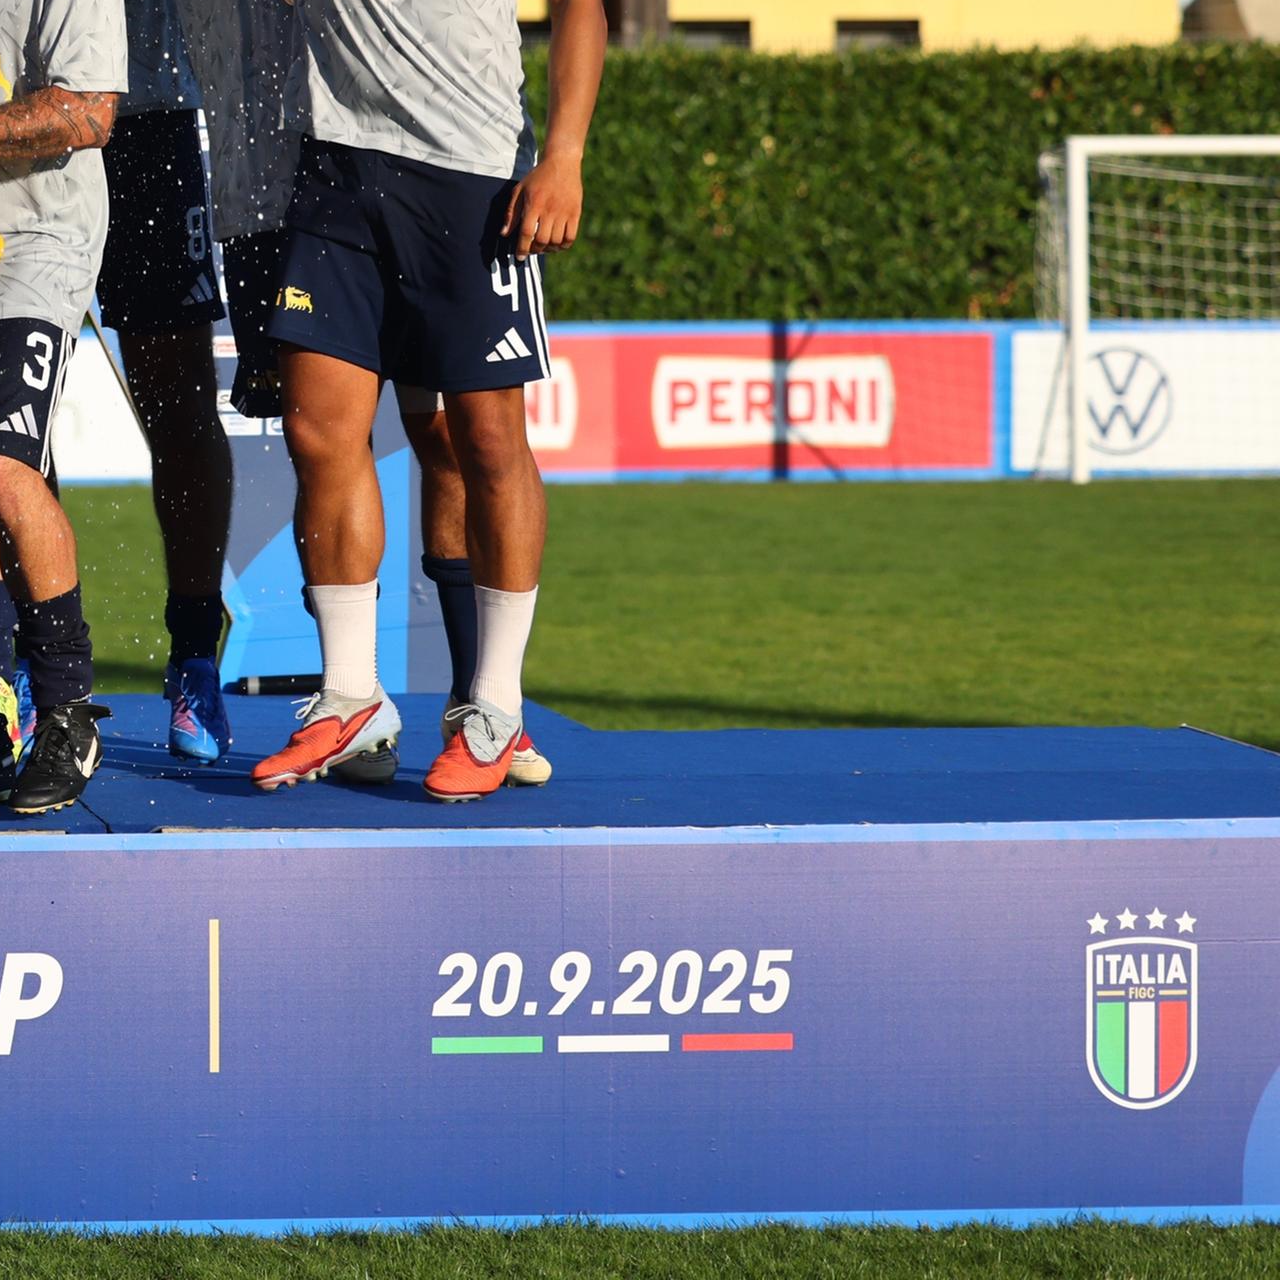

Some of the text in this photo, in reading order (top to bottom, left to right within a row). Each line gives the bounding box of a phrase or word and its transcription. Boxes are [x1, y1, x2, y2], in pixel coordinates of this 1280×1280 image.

[186, 206, 207, 261] 8
[491, 254, 520, 312] 4
[22, 331, 54, 392] 3
[668, 378, 880, 425] PERONI
[431, 949, 794, 1017] 20.9.2025
[1095, 952, 1189, 985] ITALIA
[1128, 986, 1156, 1000] FIGC
